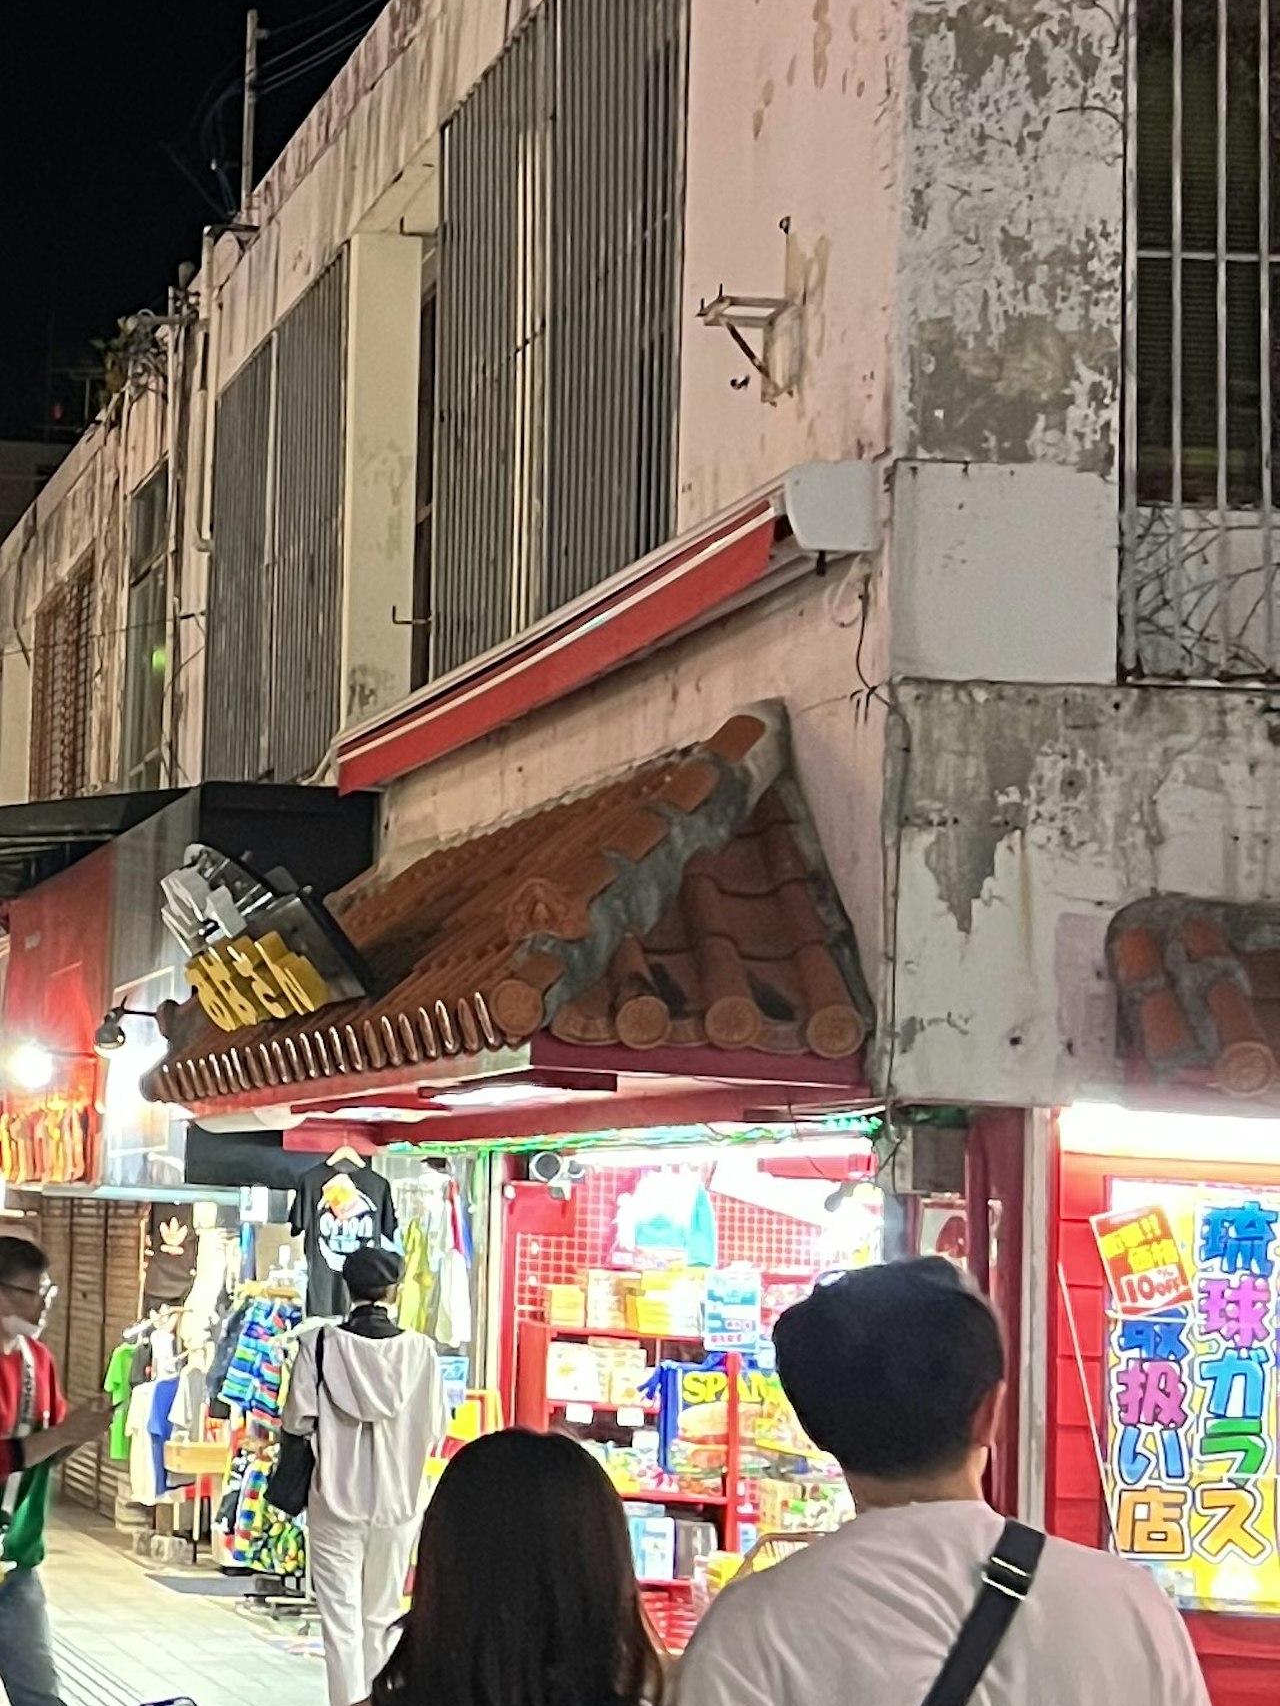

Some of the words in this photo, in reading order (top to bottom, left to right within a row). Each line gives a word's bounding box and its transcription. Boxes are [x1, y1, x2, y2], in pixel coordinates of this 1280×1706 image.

[1116, 1306, 1189, 1554] 取扱い店
[1199, 1201, 1279, 1559] 琉球ガラス
